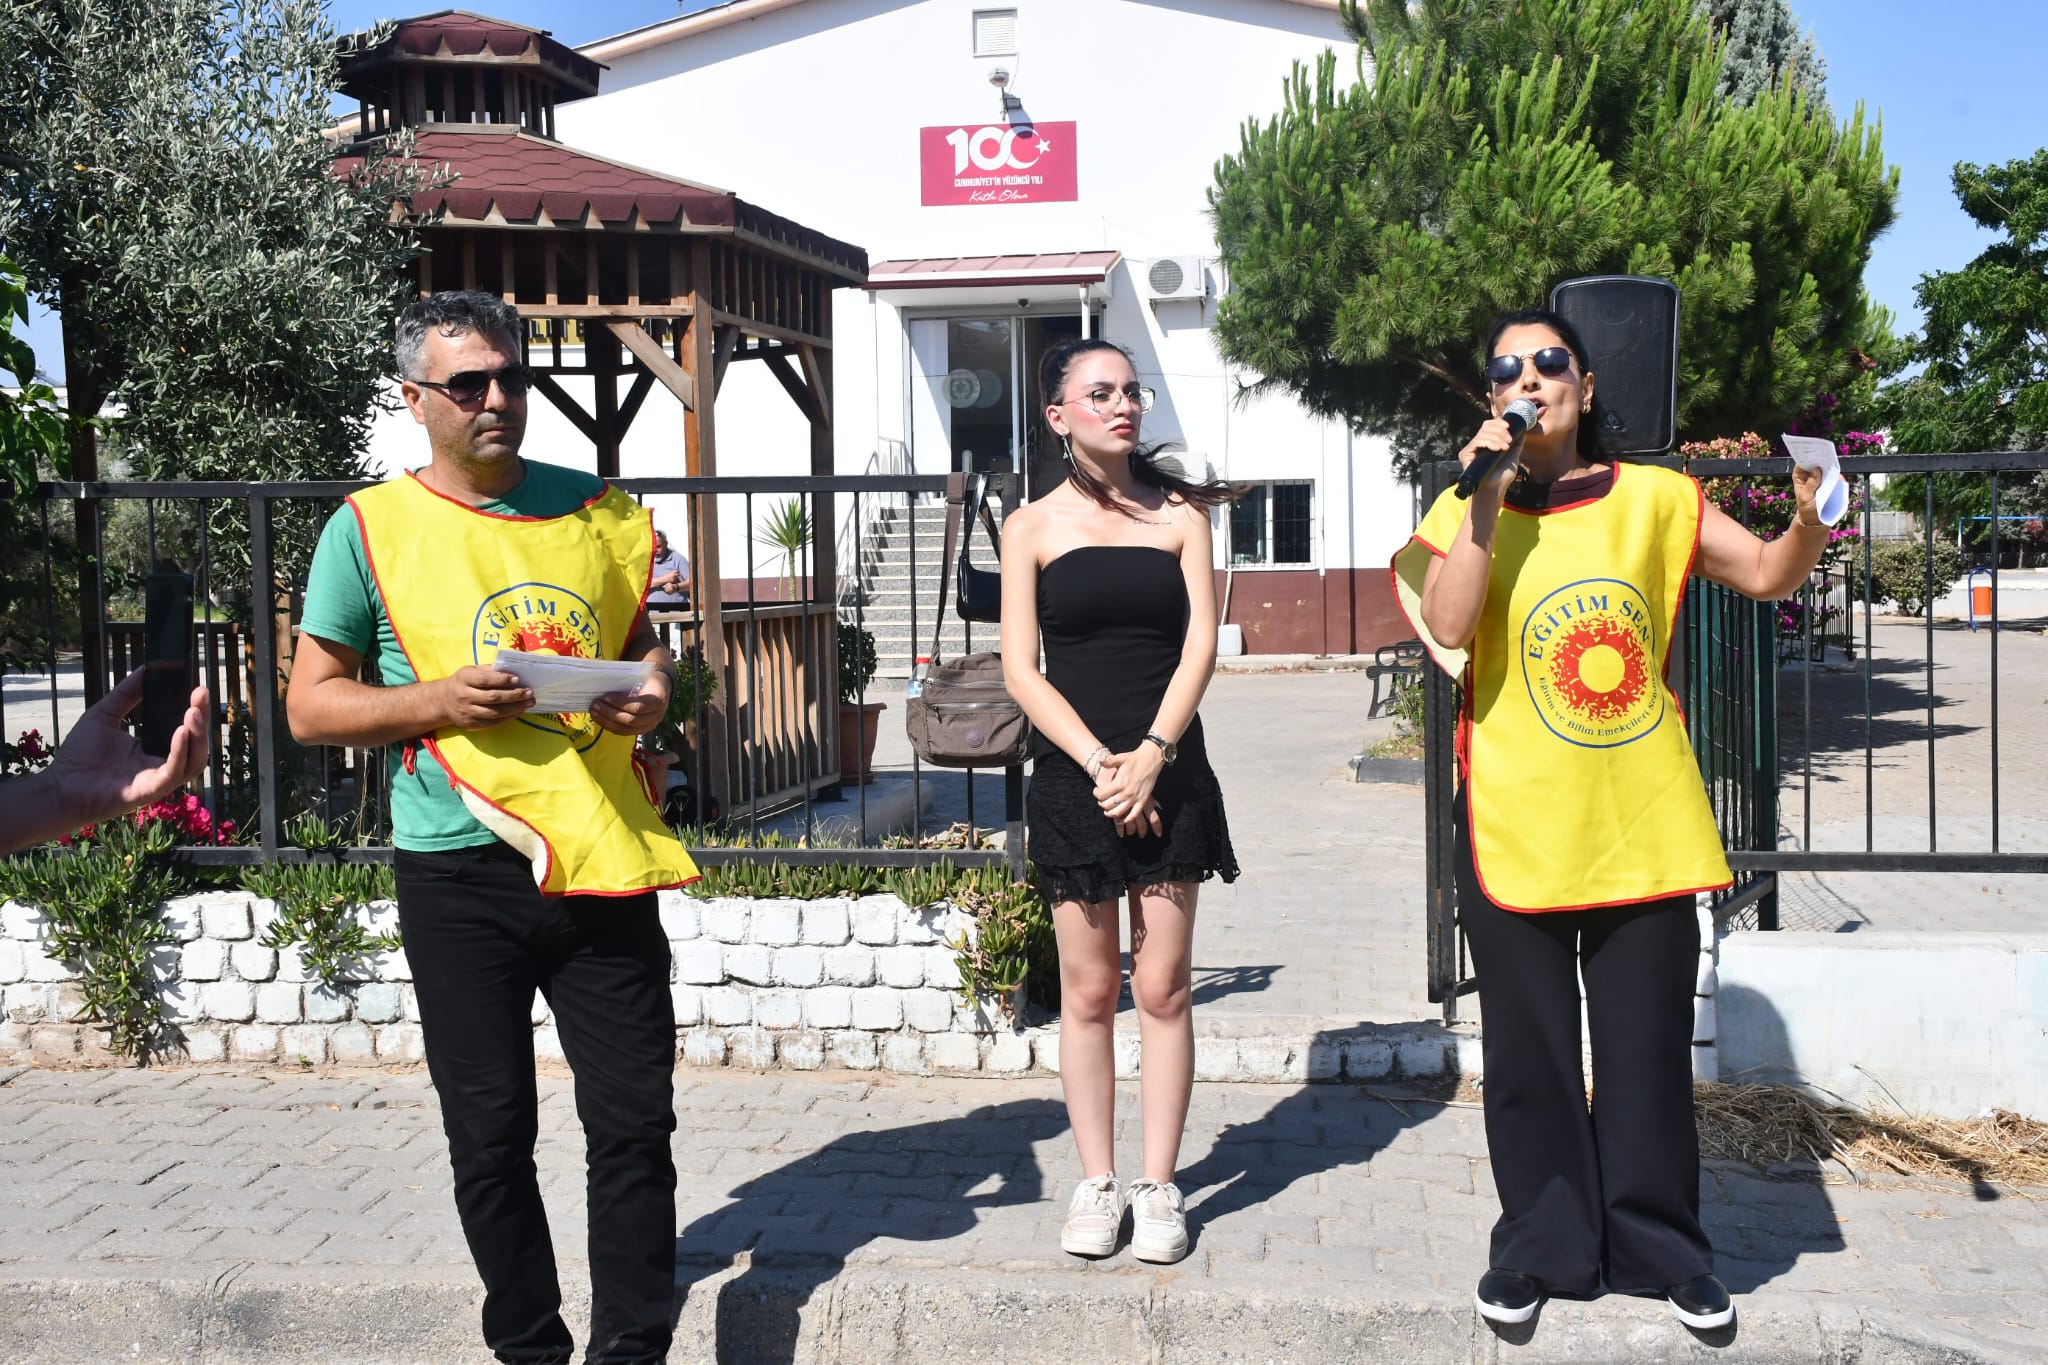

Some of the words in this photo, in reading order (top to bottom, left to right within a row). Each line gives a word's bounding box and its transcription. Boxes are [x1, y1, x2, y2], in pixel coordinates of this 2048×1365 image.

[945, 125, 1040, 176] 100
[1002, 174, 1030, 185] YÜZÜNCÜ
[1529, 594, 1609, 660] EĞİTİM
[1619, 600, 1650, 643] SEN
[1555, 711, 1566, 721] ve
[1567, 720, 1594, 736] Bilim
[1598, 709, 1650, 736] Emekçileri
